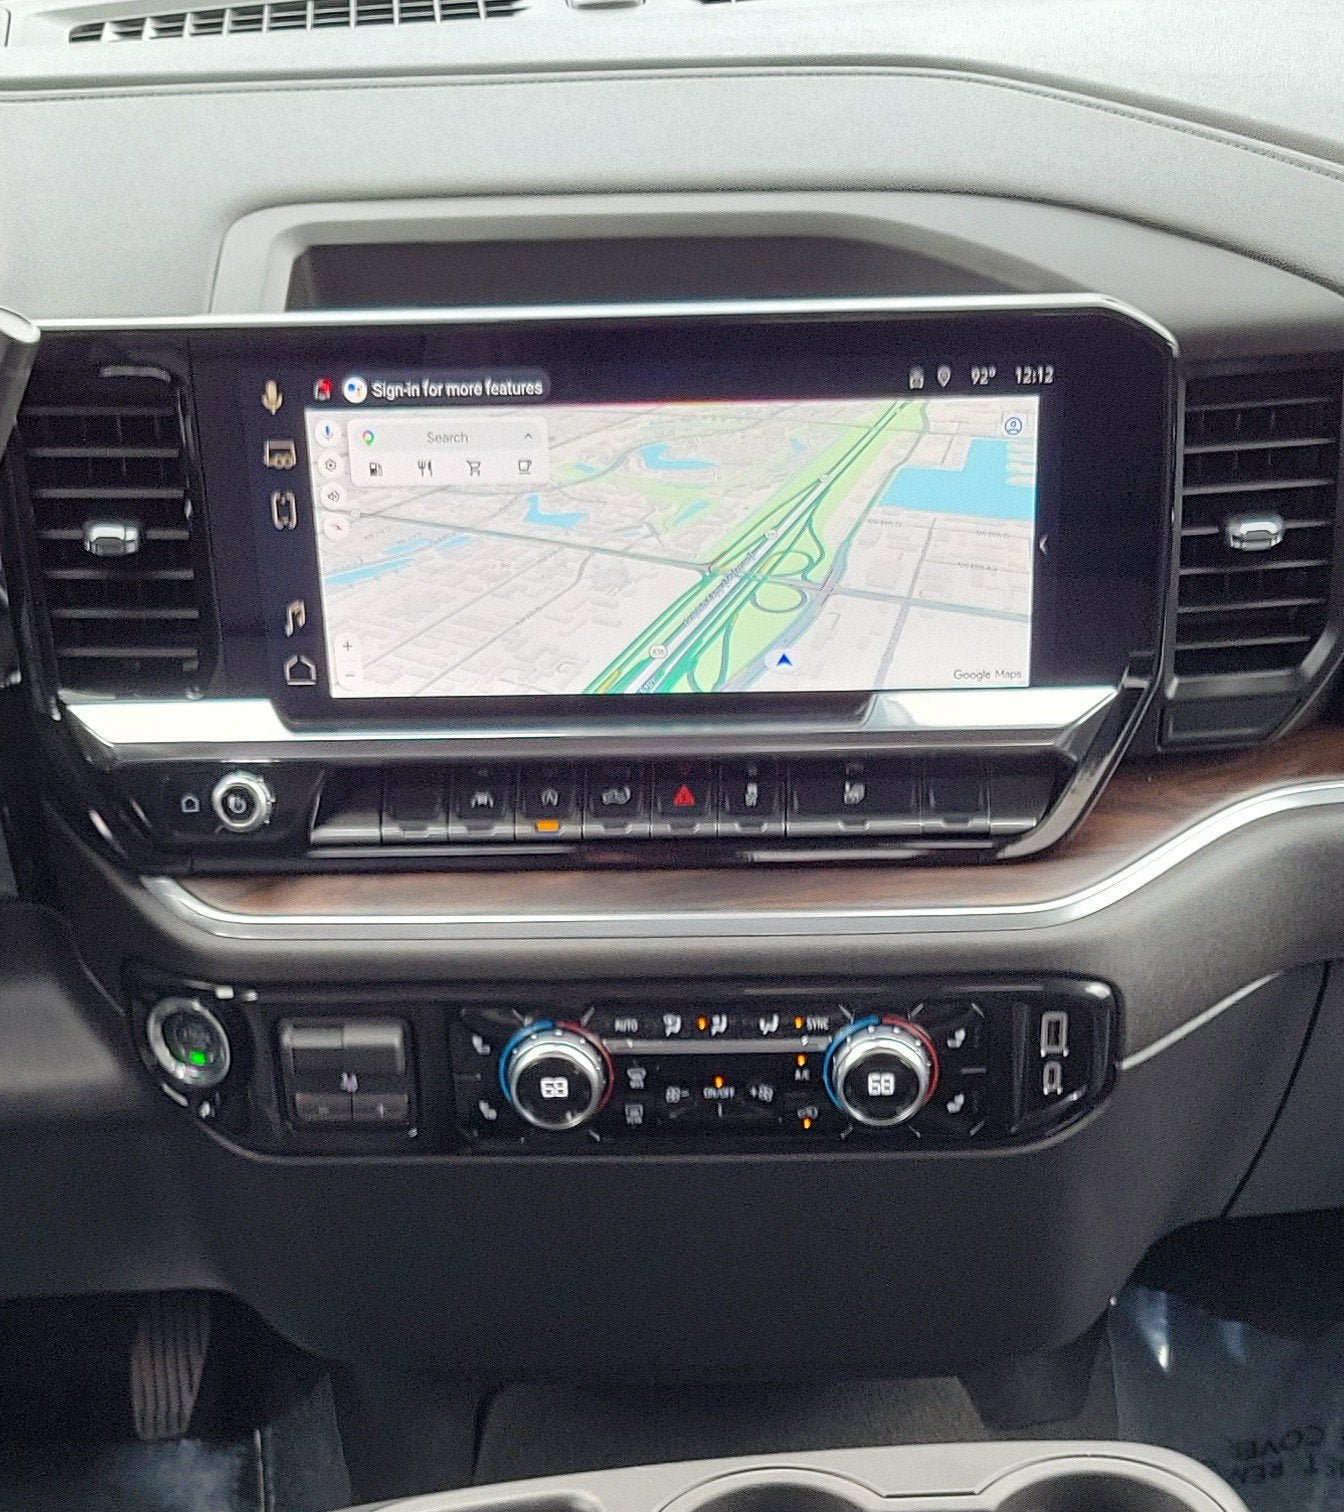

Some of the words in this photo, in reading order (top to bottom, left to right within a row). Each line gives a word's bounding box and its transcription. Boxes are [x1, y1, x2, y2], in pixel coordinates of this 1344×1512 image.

[1015, 366, 1055, 385] 12:12
[371, 380, 420, 400] Sign-in
[422, 378, 443, 397] for
[445, 381, 483, 396] more
[485, 376, 543, 396] features
[427, 431, 469, 444] Search
[953, 669, 991, 683] Google
[995, 667, 1022, 681] Maps
[614, 1018, 639, 1033] AUTO
[806, 1016, 830, 1031] SYNC
[867, 1073, 895, 1096] 68
